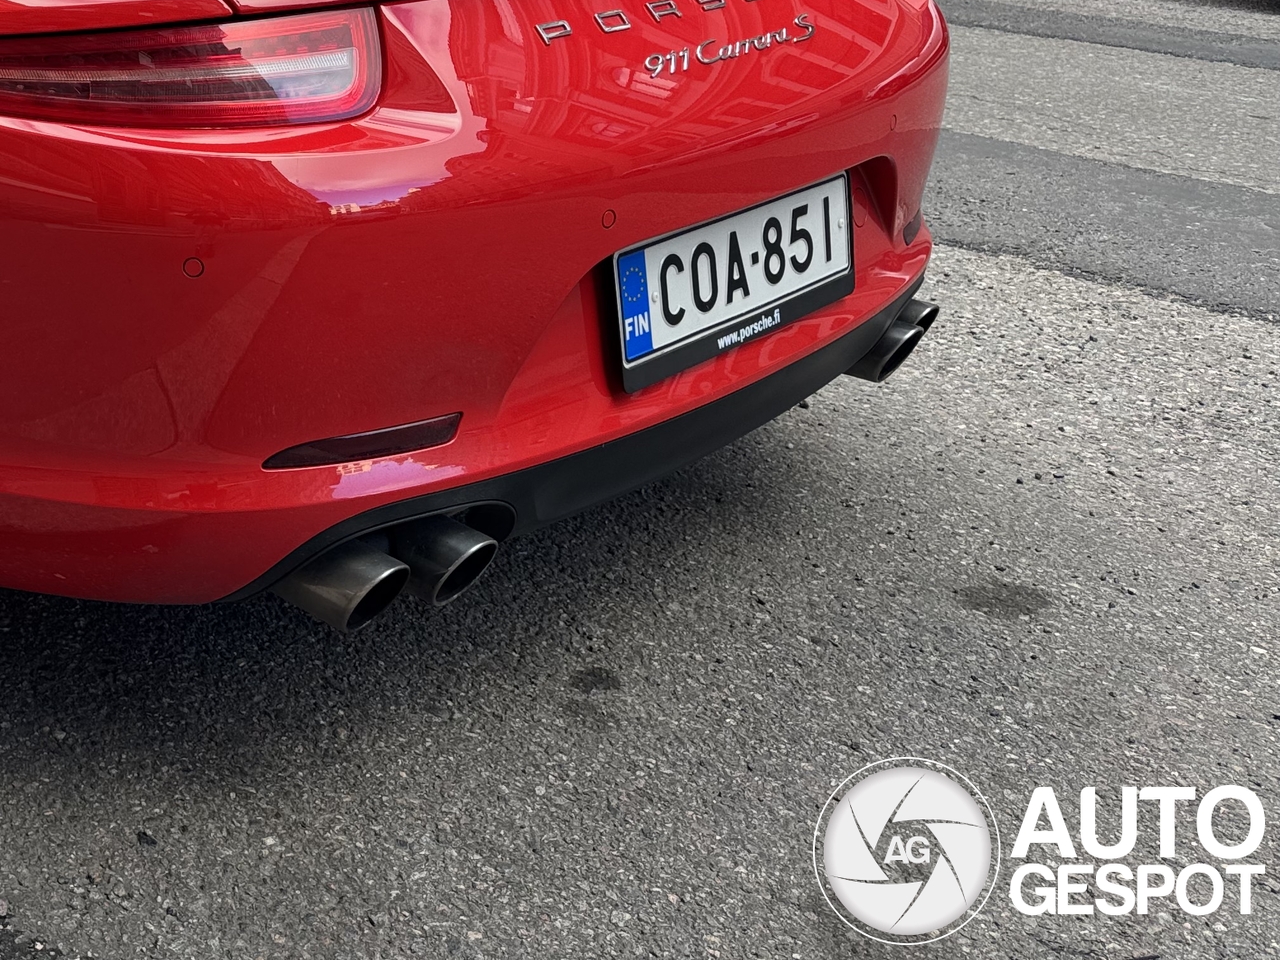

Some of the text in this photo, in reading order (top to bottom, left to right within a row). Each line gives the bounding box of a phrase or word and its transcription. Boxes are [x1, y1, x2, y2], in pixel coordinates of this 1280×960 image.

[644, 13, 816, 78] 911 Carrera S
[660, 196, 832, 326] COA-851
[624, 311, 650, 340] FIN
[717, 308, 782, 349] www.porsche.fi
